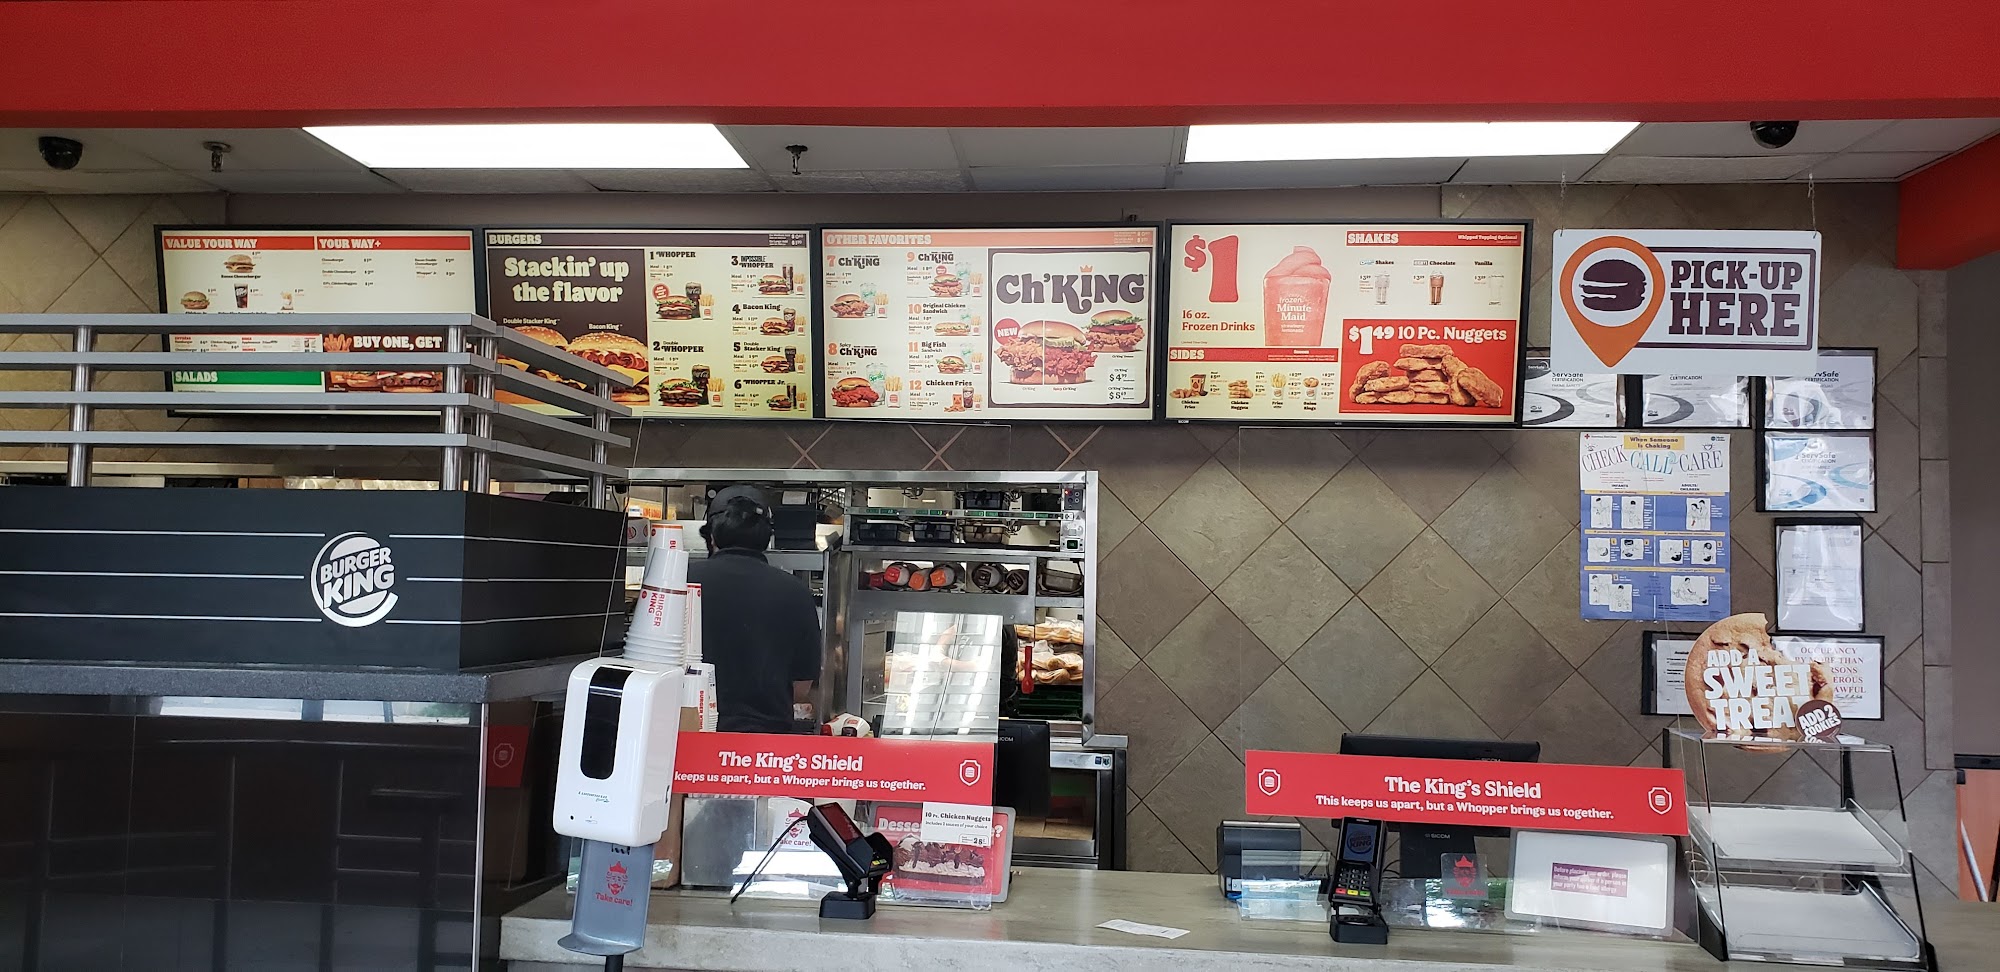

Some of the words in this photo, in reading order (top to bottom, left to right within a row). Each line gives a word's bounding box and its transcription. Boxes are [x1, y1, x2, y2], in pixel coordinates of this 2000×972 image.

[166, 239, 201, 249] VALUE
[201, 239, 232, 249] YOUR
[233, 239, 257, 249] WAY
[319, 239, 350, 249] YOUR
[489, 234, 542, 245] BURGERS
[826, 234, 867, 245] OTHER
[868, 234, 932, 245] FAVORITES
[1347, 233, 1399, 244] SHAKES
[650, 251, 654, 260] 1
[731, 255, 739, 266] 3
[826, 255, 836, 267] 7
[907, 251, 915, 262] 9
[504, 255, 597, 277] Stackin'
[599, 261, 630, 282] up
[1184, 235, 1239, 303] $1
[1670, 260, 1803, 291] PICK-UP
[512, 281, 550, 302] the
[552, 280, 623, 303] flavor
[996, 273, 1145, 314] Ch'KING
[732, 304, 740, 314] 4
[908, 303, 921, 315] 10
[1276, 304, 1312, 313] Minute
[1182, 310, 1192, 319] 16
[1280, 312, 1306, 321] Maid
[1669, 292, 1801, 337] HERE
[997, 327, 1018, 337] NEW
[1182, 322, 1219, 332] Frozen
[1220, 322, 1256, 332] Drinks
[353, 336, 383, 348] BUY
[382, 336, 415, 351] ONE,
[415, 336, 443, 348] GET
[921, 341, 932, 349] Big
[1348, 325, 1395, 355] $149
[1397, 326, 1415, 339] 10
[1417, 326, 1440, 340] Pc.
[1443, 326, 1508, 344] Nuggets
[653, 341, 661, 351] 2
[733, 341, 741, 352] 5
[828, 342, 838, 356] 8
[908, 341, 919, 352] 11
[1170, 349, 1205, 360] SIDES
[175, 371, 218, 382] SALADS
[734, 379, 742, 390] 6
[909, 380, 922, 390] 12
[1581, 445, 1628, 472] CHECK
[1630, 450, 1674, 475] CALL
[1679, 450, 1723, 472] CARE
[320, 547, 391, 584] BURGER
[323, 564, 395, 609] KING
[648, 592, 658, 614] KING
[652, 594, 665, 628] BURGER
[1800, 647, 1858, 655] OCCUPANCY
[1707, 650, 1743, 667] ADD
[1746, 649, 1760, 665] A
[1839, 656, 1864, 664] THAN
[1703, 664, 1811, 700] SWEET
[1798, 708, 1826, 730] ADD
[1823, 704, 1838, 718] 2
[1804, 716, 1841, 738] COOKIES
[718, 751, 752, 768] The
[754, 752, 808, 772] King's
[810, 754, 863, 772] Shield
[674, 770, 705, 782] keeps
[706, 773, 719, 782] us
[720, 773, 752, 785] apart,
[754, 773, 771, 784] but
[773, 776, 781, 785] a
[782, 775, 830, 788] Whopper
[831, 777, 864, 790] brings
[865, 779, 878, 788] us
[879, 779, 927, 791] together.
[1384, 775, 1421, 793] The
[1424, 777, 1481, 798] King's
[1484, 780, 1542, 799] Shield
[1315, 795, 1340, 806] This
[1341, 796, 1373, 809] keeps
[1375, 799, 1389, 808] us
[1390, 799, 1424, 811] apart,
[1426, 801, 1445, 811] but
[1446, 803, 1454, 811] a
[1456, 801, 1508, 815] Whopper
[1510, 804, 1545, 817] brings
[1547, 806, 1561, 816] us
[1562, 806, 1615, 819] together.
[940, 812, 965, 820] Chicken
[966, 814, 991, 823] Nuggets
[878, 818, 922, 832] Desse
[793, 838, 812, 847] care!
[1563, 881, 1576, 889] party
[1604, 879, 1621, 887] person
[595, 892, 613, 904] Take
[614, 896, 633, 906] care!
